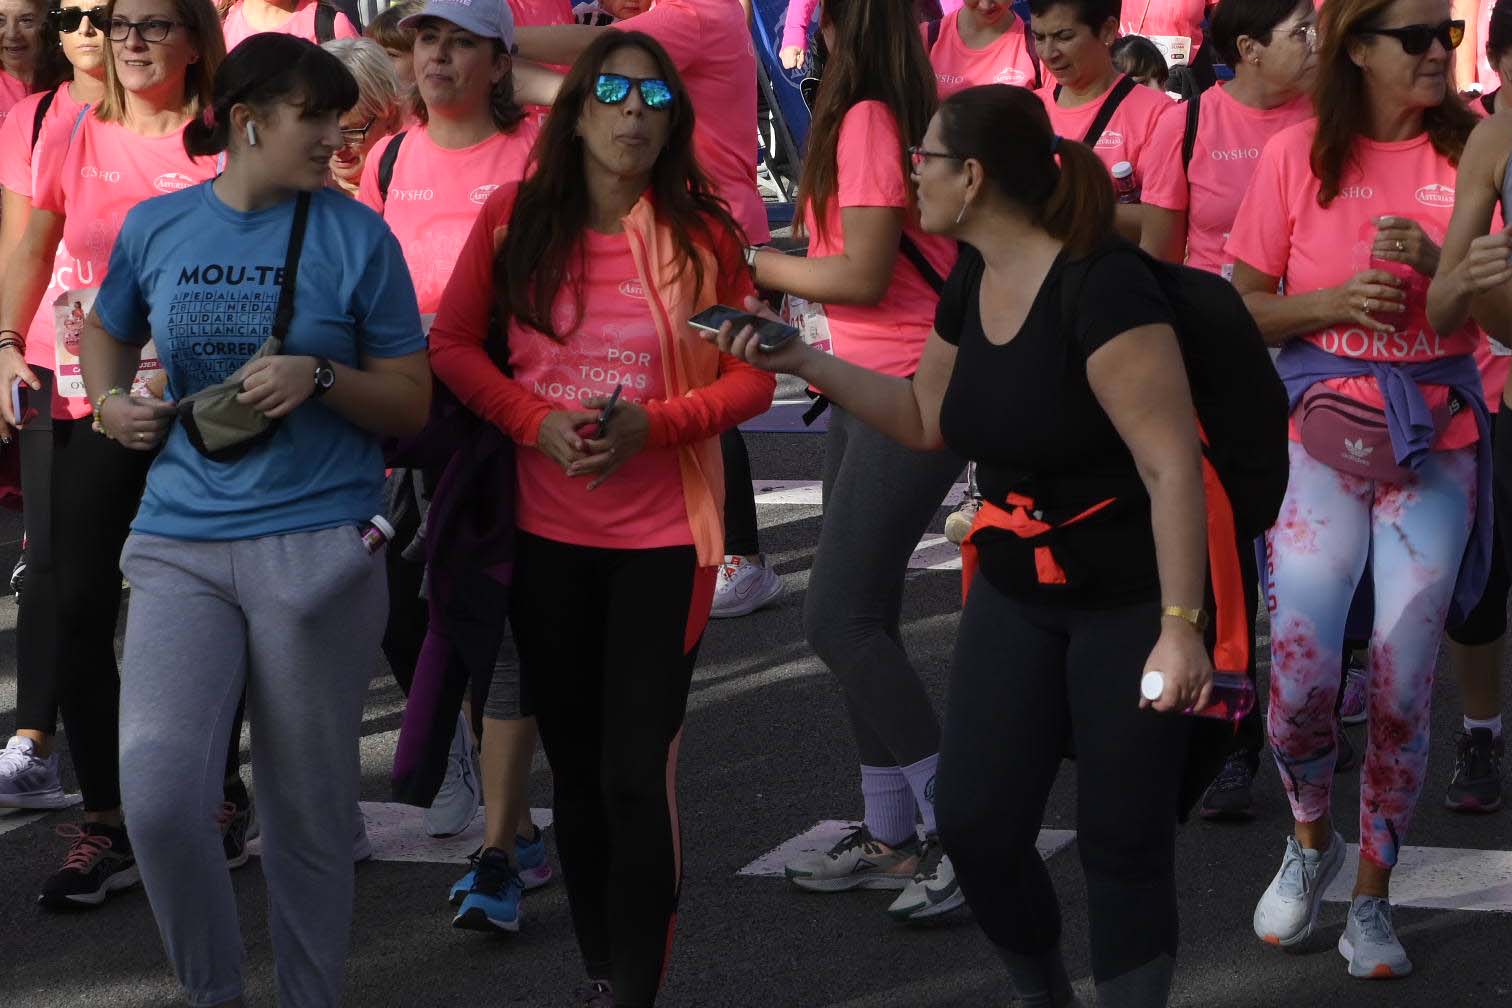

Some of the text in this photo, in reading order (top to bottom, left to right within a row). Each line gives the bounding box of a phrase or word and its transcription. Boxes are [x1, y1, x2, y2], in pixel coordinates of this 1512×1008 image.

[1211, 147, 1259, 161] OYSHO
[1322, 328, 1446, 358] DORSAL
[607, 347, 651, 367] POR
[579, 365, 647, 390] TODAS
